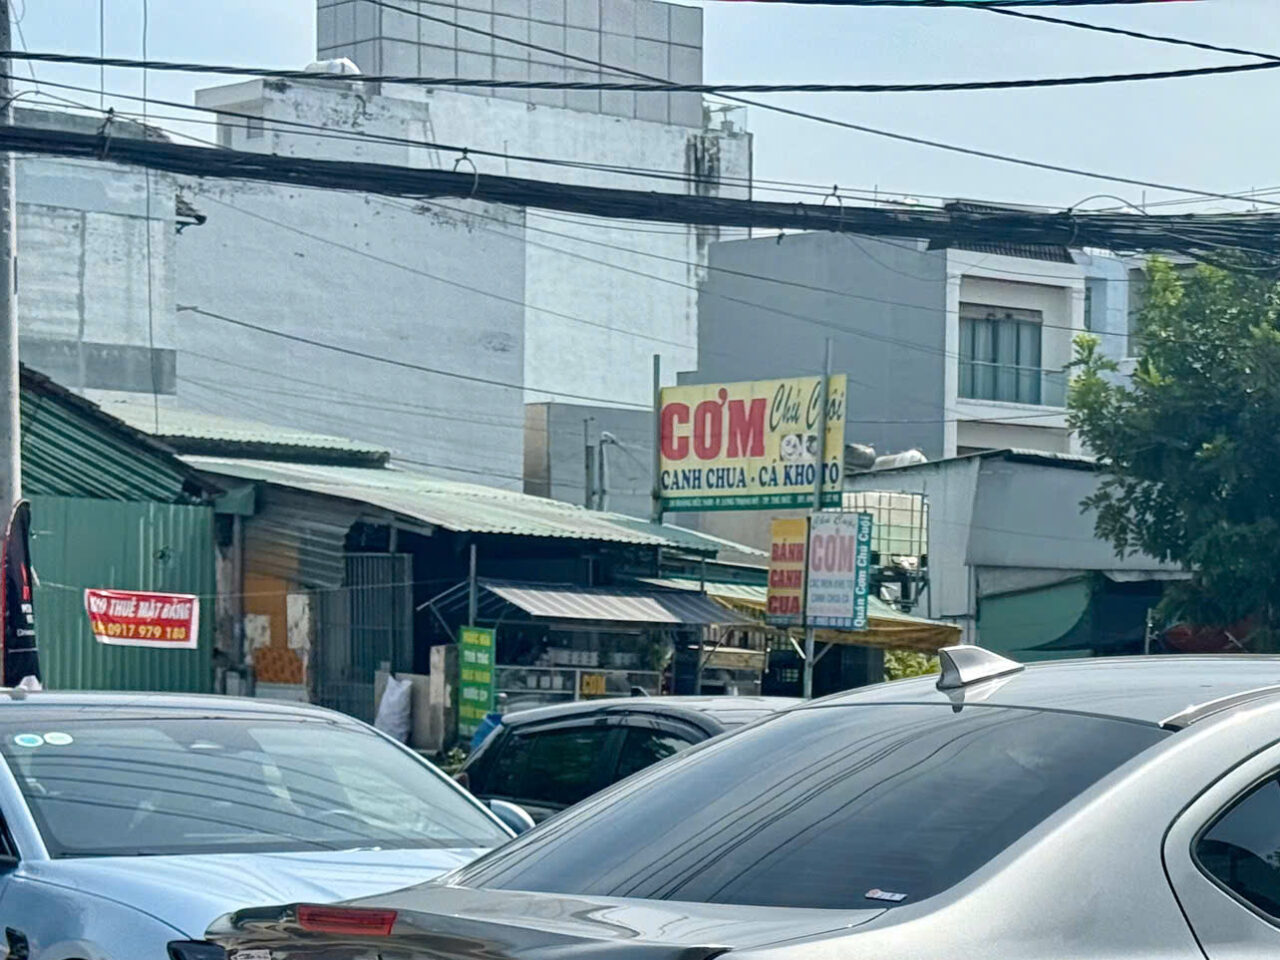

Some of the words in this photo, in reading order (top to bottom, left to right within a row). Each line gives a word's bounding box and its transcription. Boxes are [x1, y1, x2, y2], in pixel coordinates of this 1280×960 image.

[806, 381, 844, 434] Cội
[661, 388, 767, 461] CƠM
[661, 467, 702, 490] CANH
[706, 466, 747, 488] CHUA
[759, 458, 778, 487] CÁ
[783, 463, 816, 486] KHO
[771, 538, 804, 562] BÁNH
[811, 527, 855, 573] CƠM
[770, 569, 802, 588] CANH
[767, 595, 800, 614] CUA
[139, 625, 162, 638] 979
